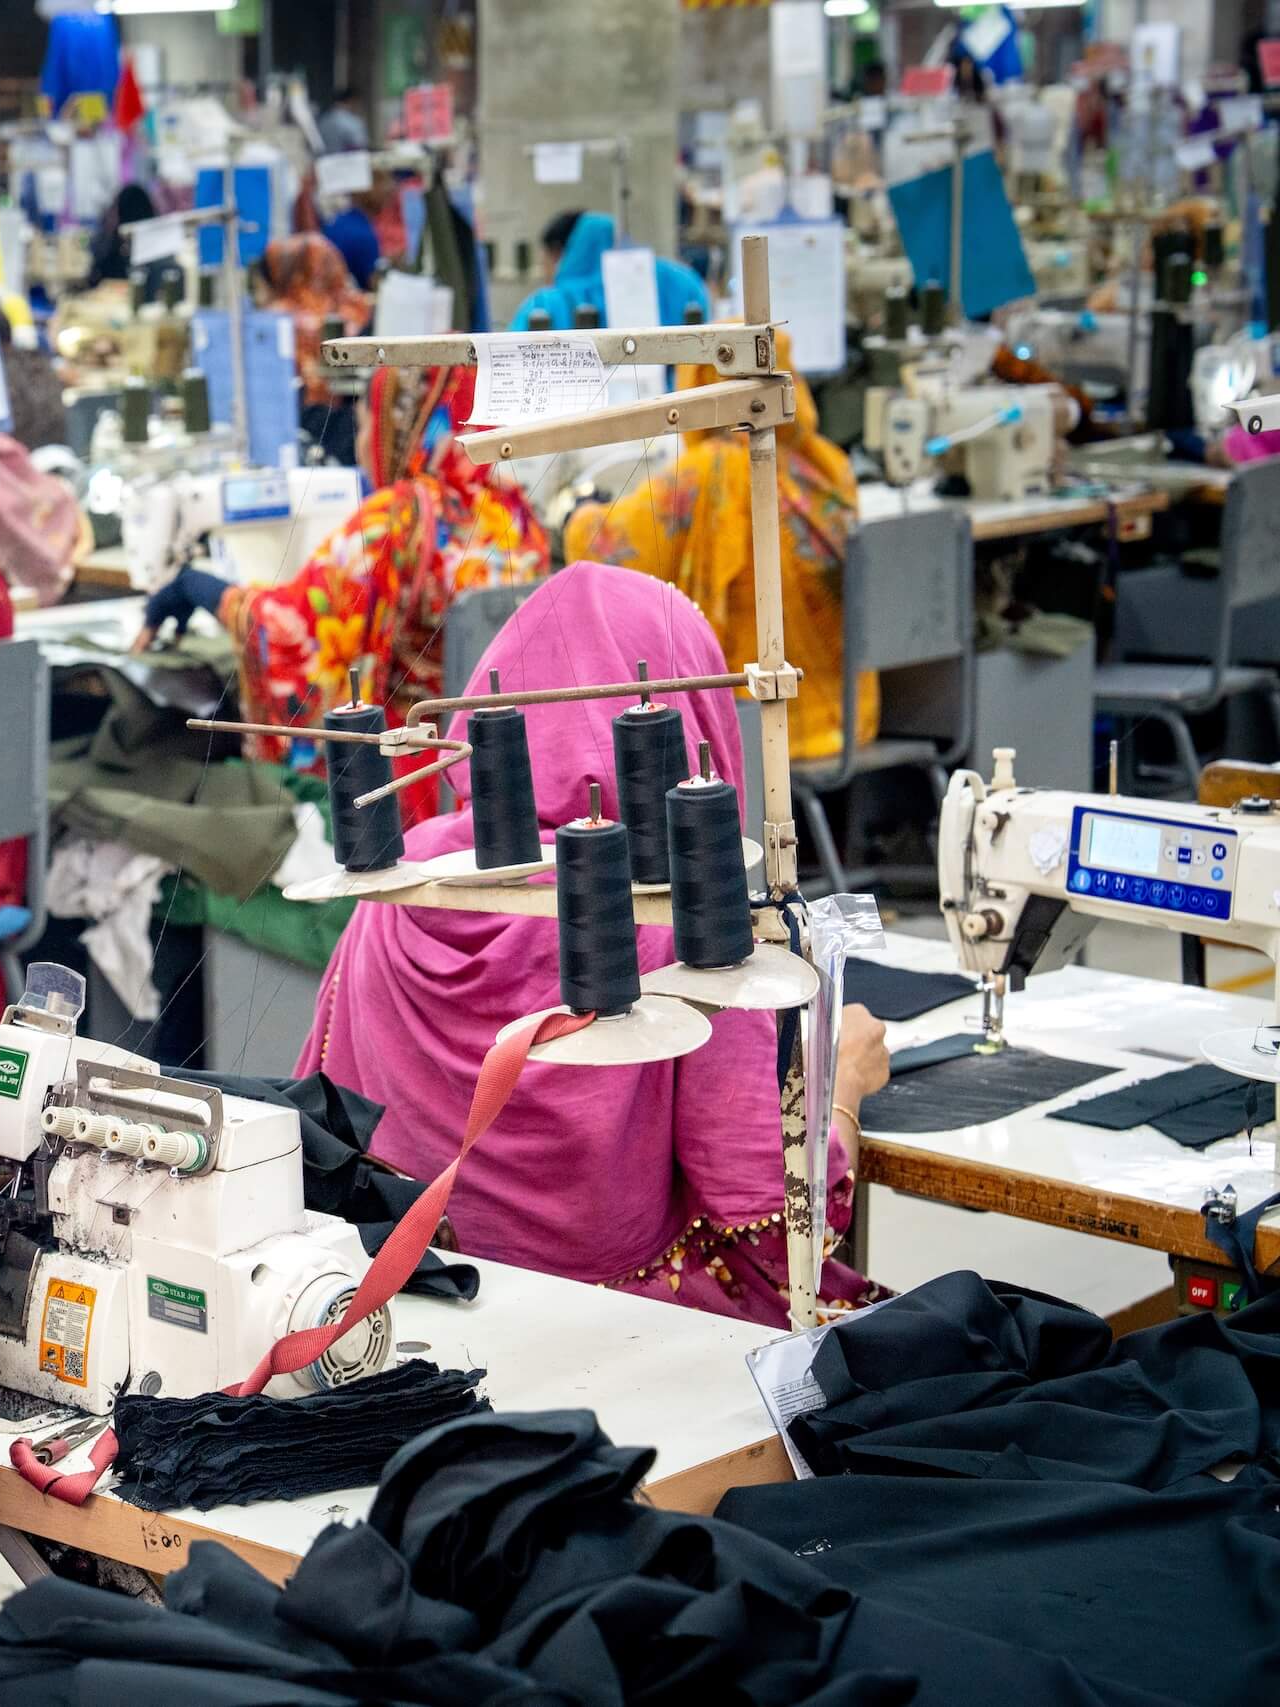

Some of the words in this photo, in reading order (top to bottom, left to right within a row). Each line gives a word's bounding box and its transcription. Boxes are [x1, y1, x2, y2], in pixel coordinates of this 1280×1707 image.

[7, 1077, 19, 1086] JOY
[169, 1287, 186, 1299] STAR
[187, 1292, 200, 1303] JOY
[1191, 1286, 1208, 1298] OFF
